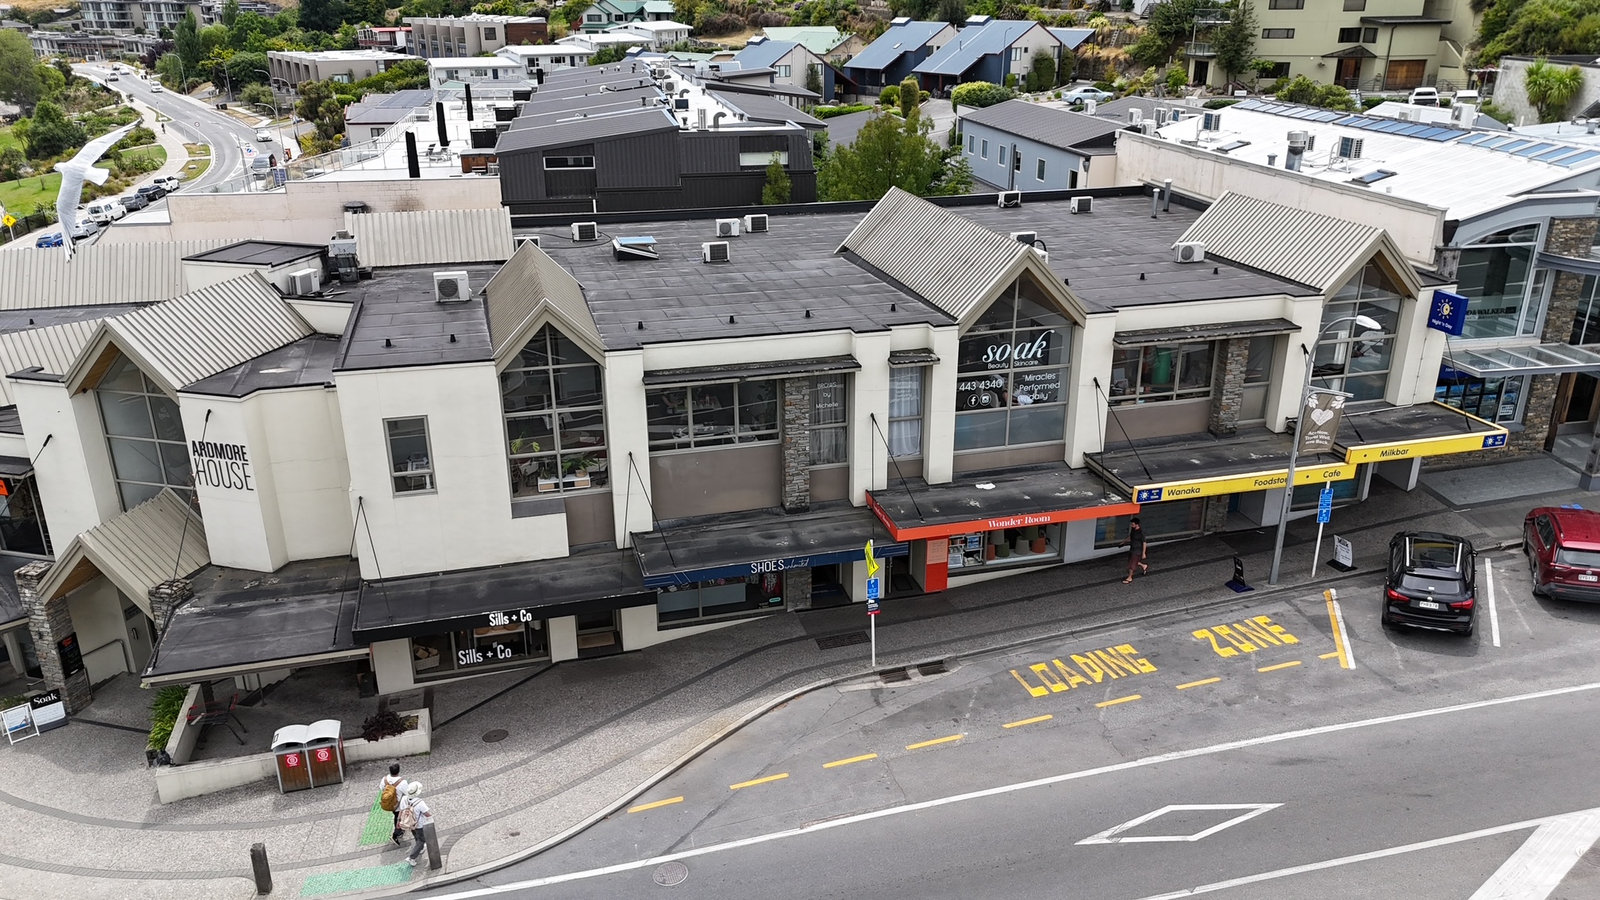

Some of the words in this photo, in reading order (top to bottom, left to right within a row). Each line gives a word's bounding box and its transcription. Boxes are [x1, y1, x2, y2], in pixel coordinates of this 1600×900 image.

[982, 329, 1055, 363] soak
[959, 381, 976, 391] 443
[978, 378, 1003, 389] 4340
[1020, 381, 1060, 393] Performed
[192, 440, 249, 462] ARDMORE
[1379, 448, 1410, 457] Milkbar
[194, 458, 254, 491] HOUSE
[1167, 486, 1201, 496] Wanaka
[1323, 469, 1341, 478] Cafe
[988, 518, 1023, 528] Wonder
[1025, 516, 1051, 524] Room
[751, 559, 785, 574] SHOES
[489, 612, 509, 626] Sills
[520, 609, 532, 623] Co
[458, 648, 484, 665] Sills
[496, 645, 512, 659] Co
[1009, 643, 1158, 698] LOADING
[1192, 615, 1300, 658] ZONE
[33, 692, 58, 705] Soak
